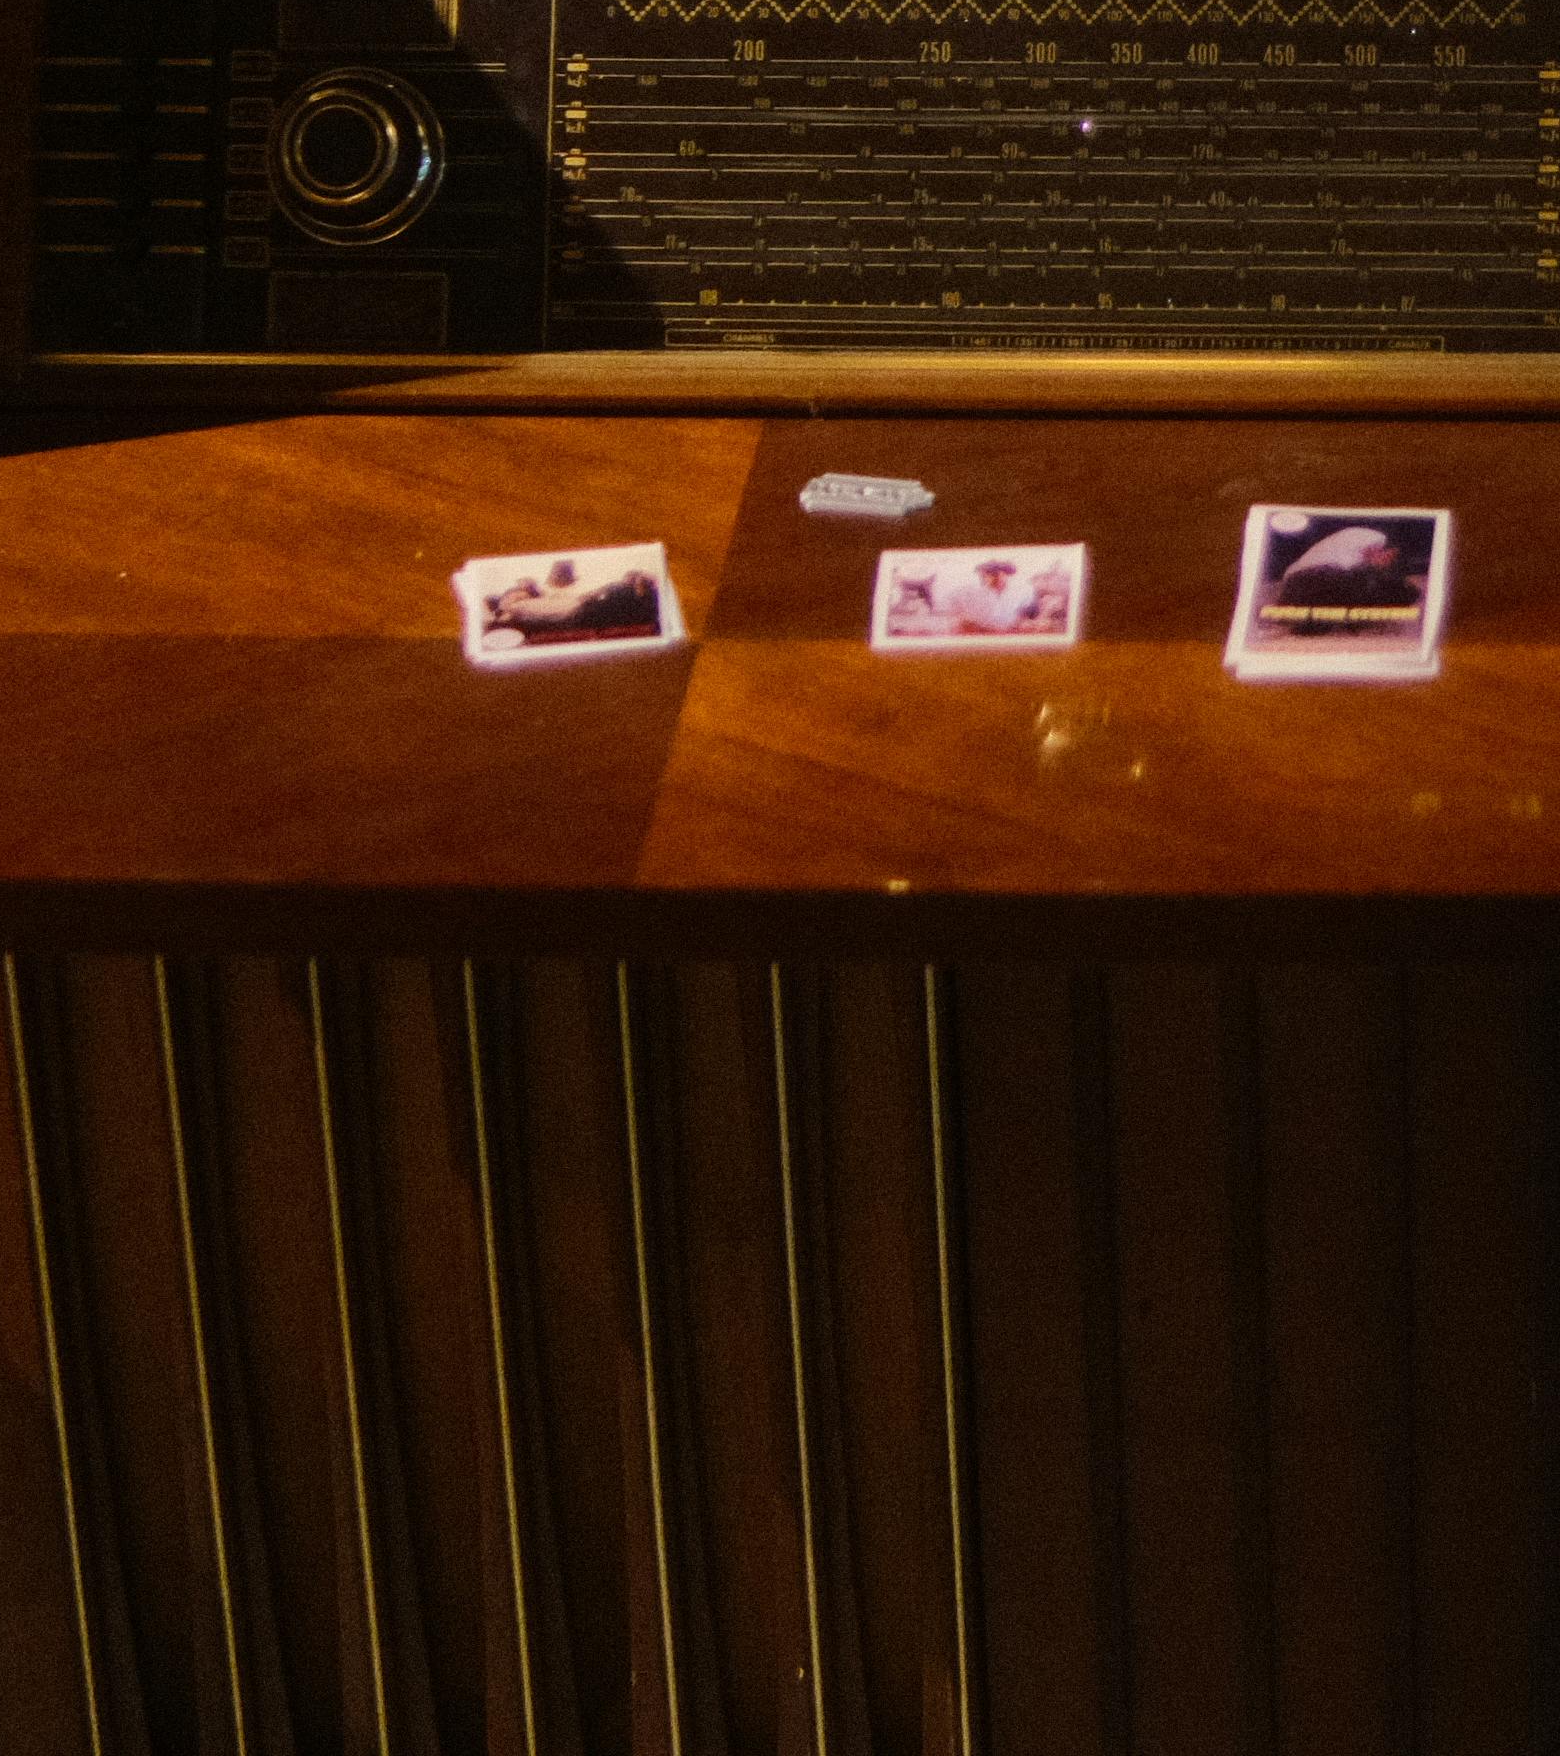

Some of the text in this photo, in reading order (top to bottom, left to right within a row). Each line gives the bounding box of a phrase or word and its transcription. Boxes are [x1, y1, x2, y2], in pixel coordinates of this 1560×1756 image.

[733, 39, 1467, 68] 200 250 300 350 400 450 500 550
